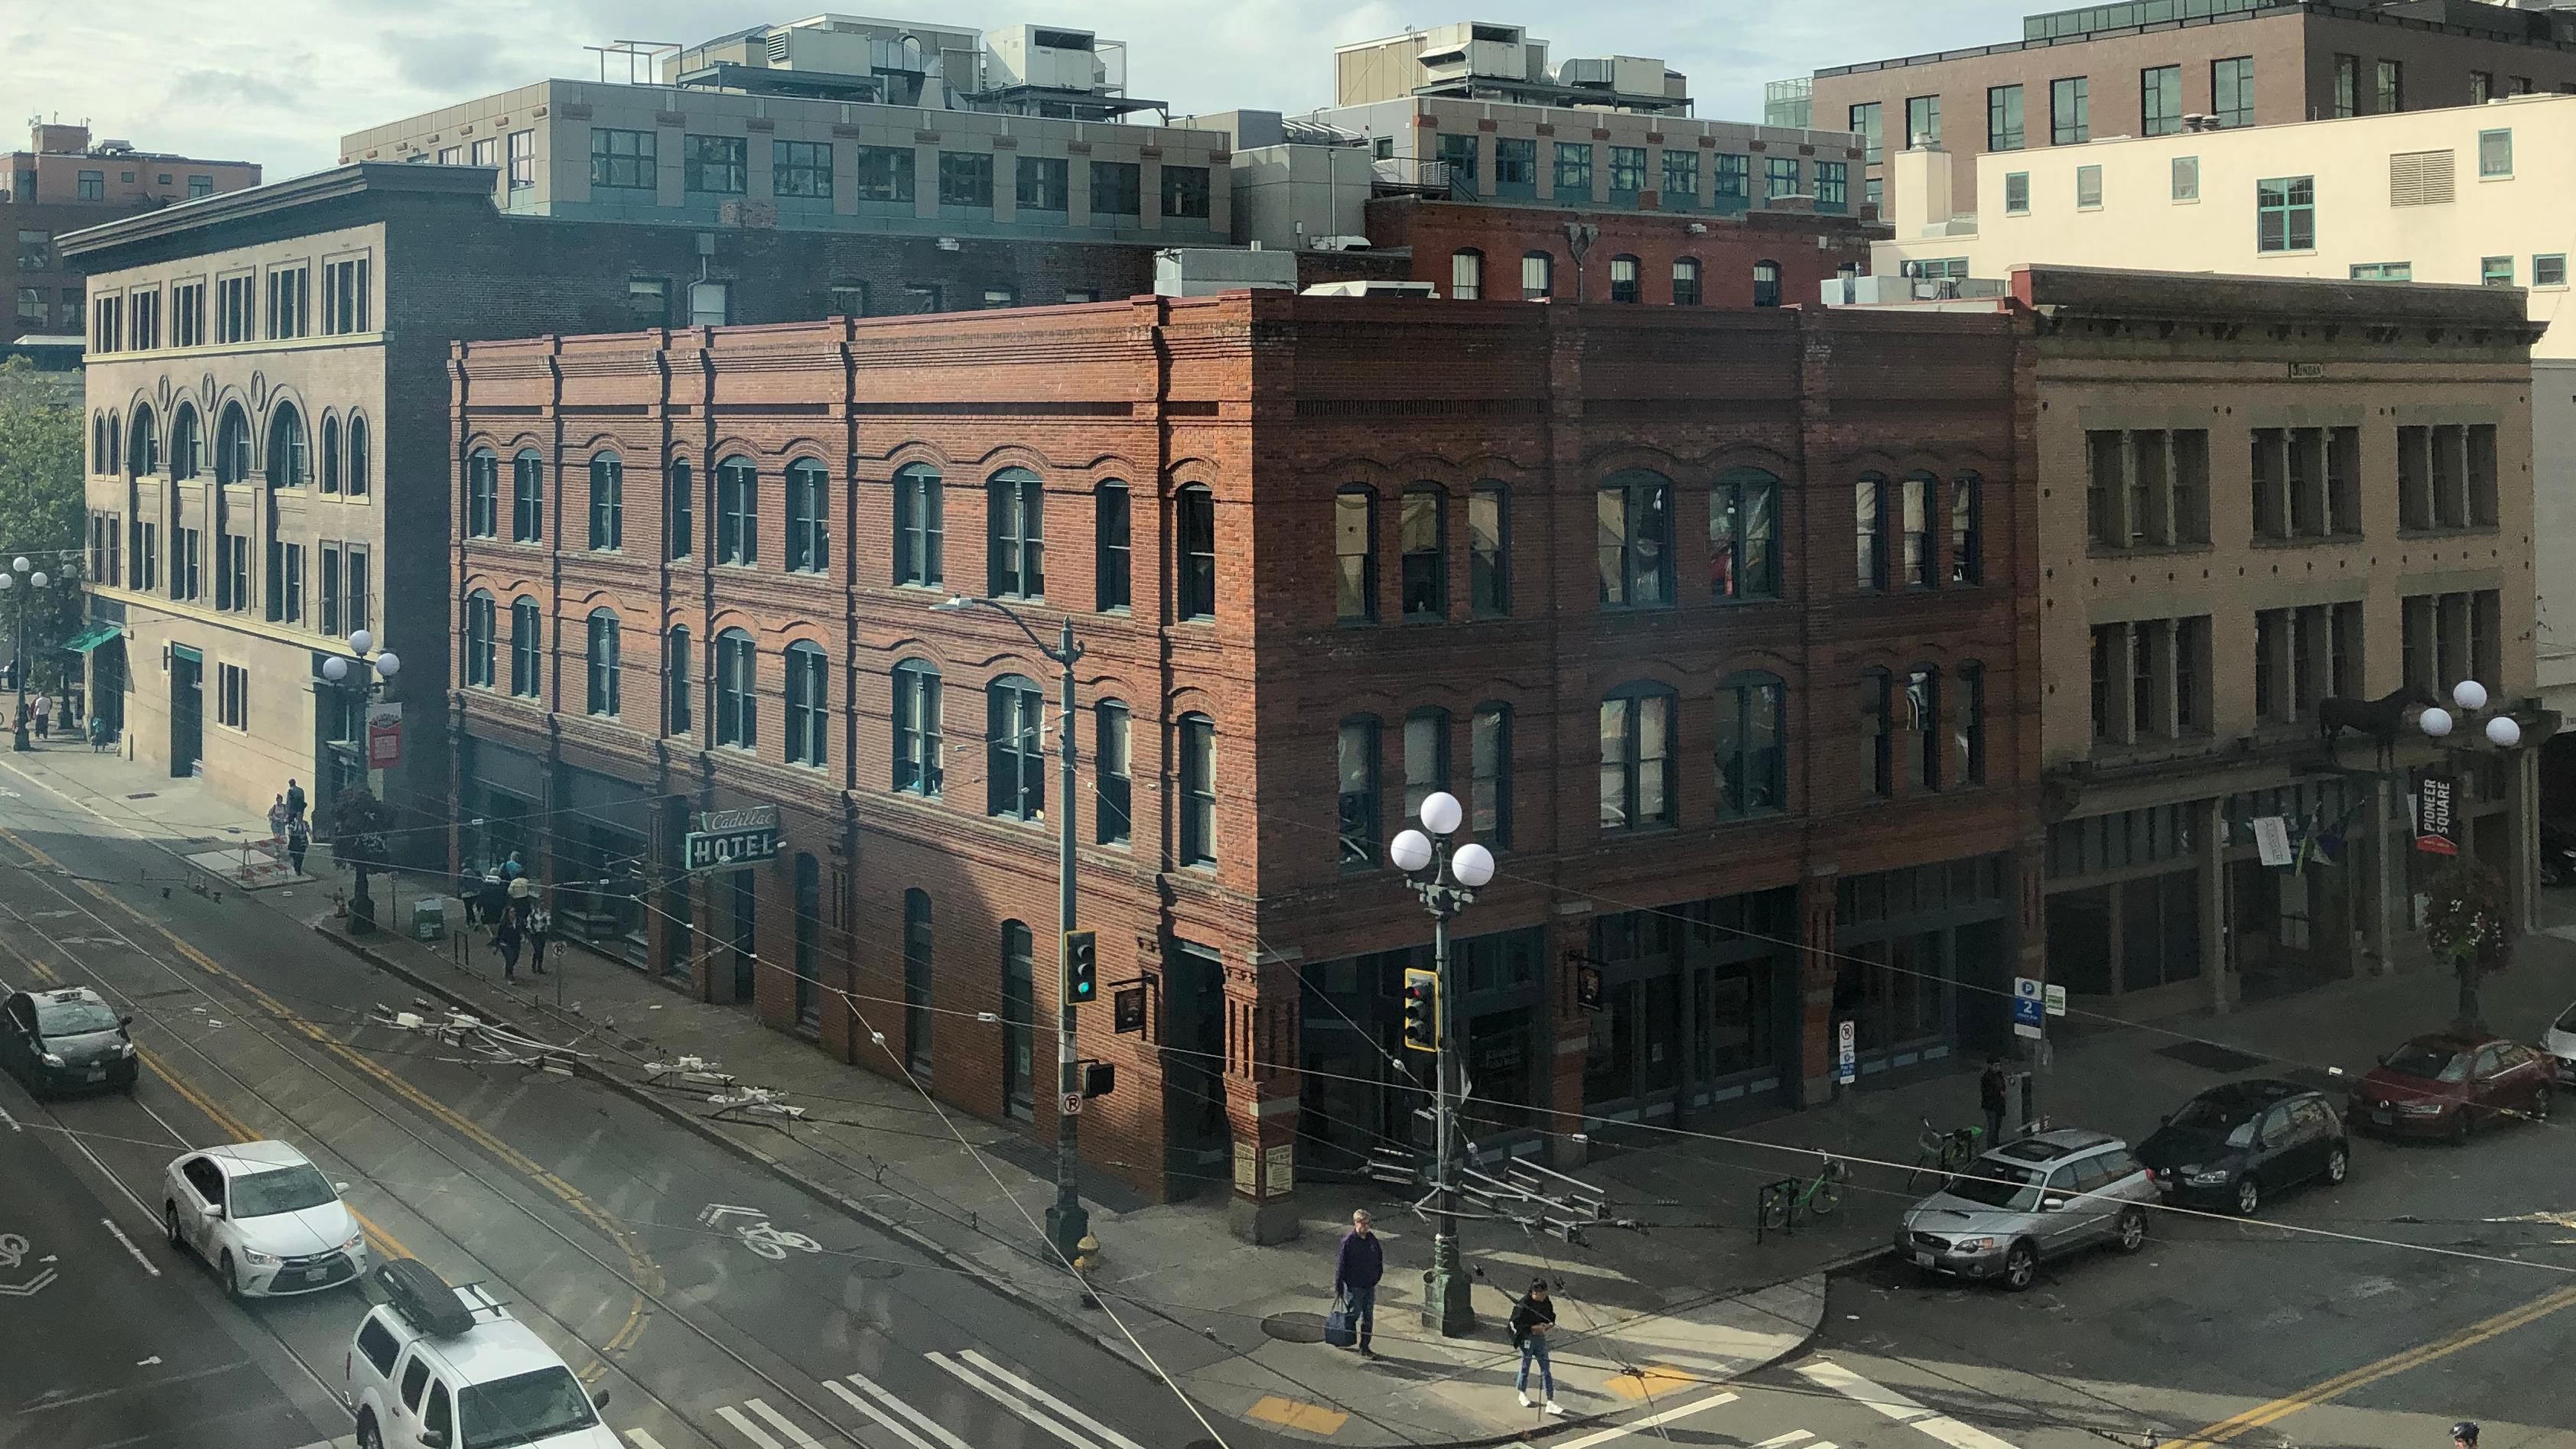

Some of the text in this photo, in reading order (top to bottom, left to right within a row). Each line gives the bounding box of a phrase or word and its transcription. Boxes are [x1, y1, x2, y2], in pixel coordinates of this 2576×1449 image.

[2423, 778, 2436, 832] PIONEER
[2437, 781, 2451, 835] SQUARE
[711, 811, 775, 830] Cadillac
[694, 833, 774, 863] HOTEL
[2023, 1001, 2033, 1014] 2
